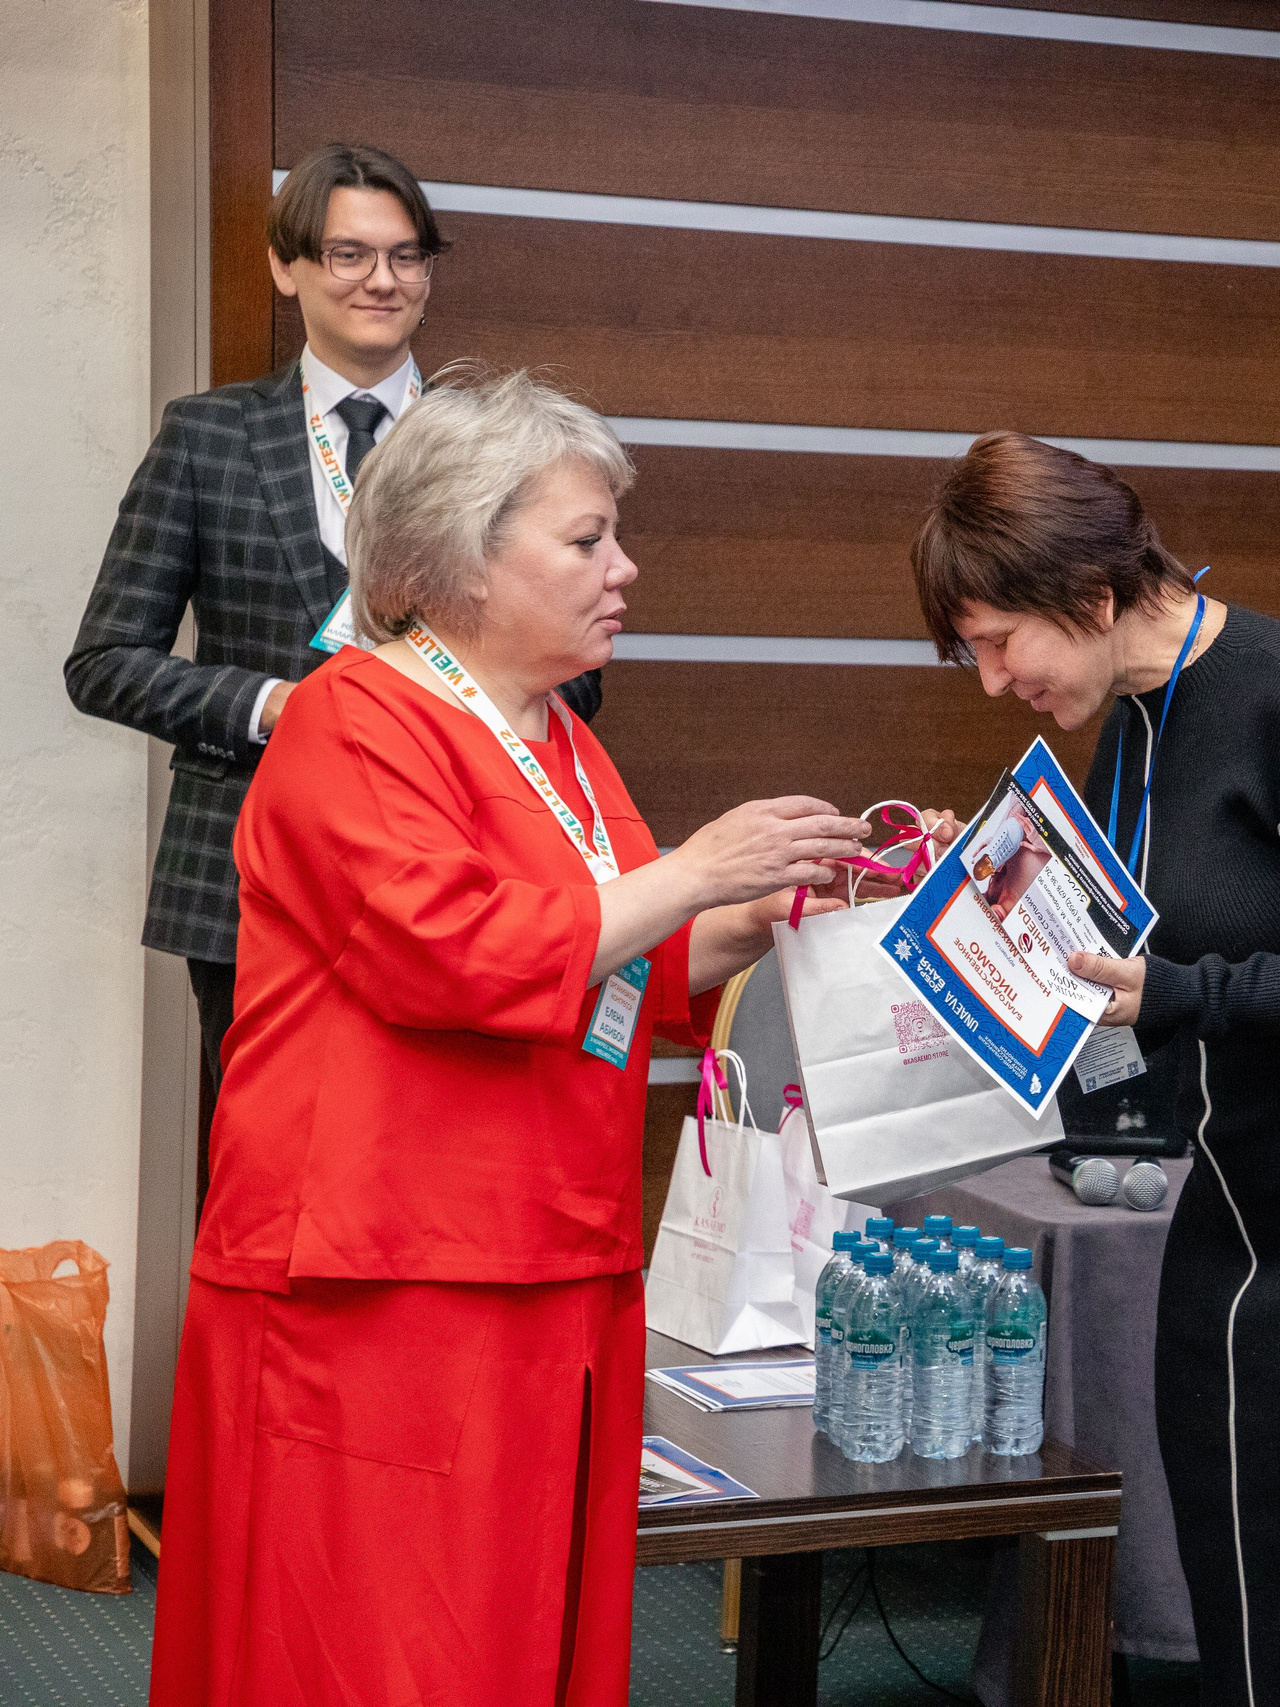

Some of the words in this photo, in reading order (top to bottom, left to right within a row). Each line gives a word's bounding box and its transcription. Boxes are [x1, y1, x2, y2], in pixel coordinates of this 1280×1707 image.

[309, 413, 323, 432] 72
[315, 432, 350, 502] WELLFEST
[499, 727, 521, 751] 72
[518, 755, 582, 844] WELLFEST
[1037, 875, 1044, 885] 90
[1044, 865, 1052, 875] 26
[1050, 875, 1058, 885] 38
[1043, 884, 1060, 909] Горького
[1056, 884, 1067, 898] 678
[1024, 894, 1049, 929] стельки
[1064, 897, 1078, 916] (952)
[1100, 903, 1117, 924] действия
[972, 892, 1018, 957] Михайловне
[1016, 903, 1050, 955] WHIEDA
[1116, 922, 1128, 935] Срок
[899, 924, 922, 953] ЕВРАЗИЯ
[1070, 927, 1086, 950] Тюмень
[916, 963, 941, 993] ДОБРА
[919, 955, 946, 988] БАНЯ
[953, 937, 1022, 1020] БЛАГОДАРСТВЕННОЕ
[969, 943, 1017, 1001] ПИСЬМО
[1017, 956, 1050, 997] Наталье
[1048, 968, 1077, 989] 40%
[605, 1006, 623, 1025] ЕЛЕНА
[944, 990, 979, 1032] UNAEVA
[902, 1050, 948, 1065] @KASAEMO.STORE
[977, 1034, 1023, 1080] ЗАПАДНО-СИБИРСКИЙ
